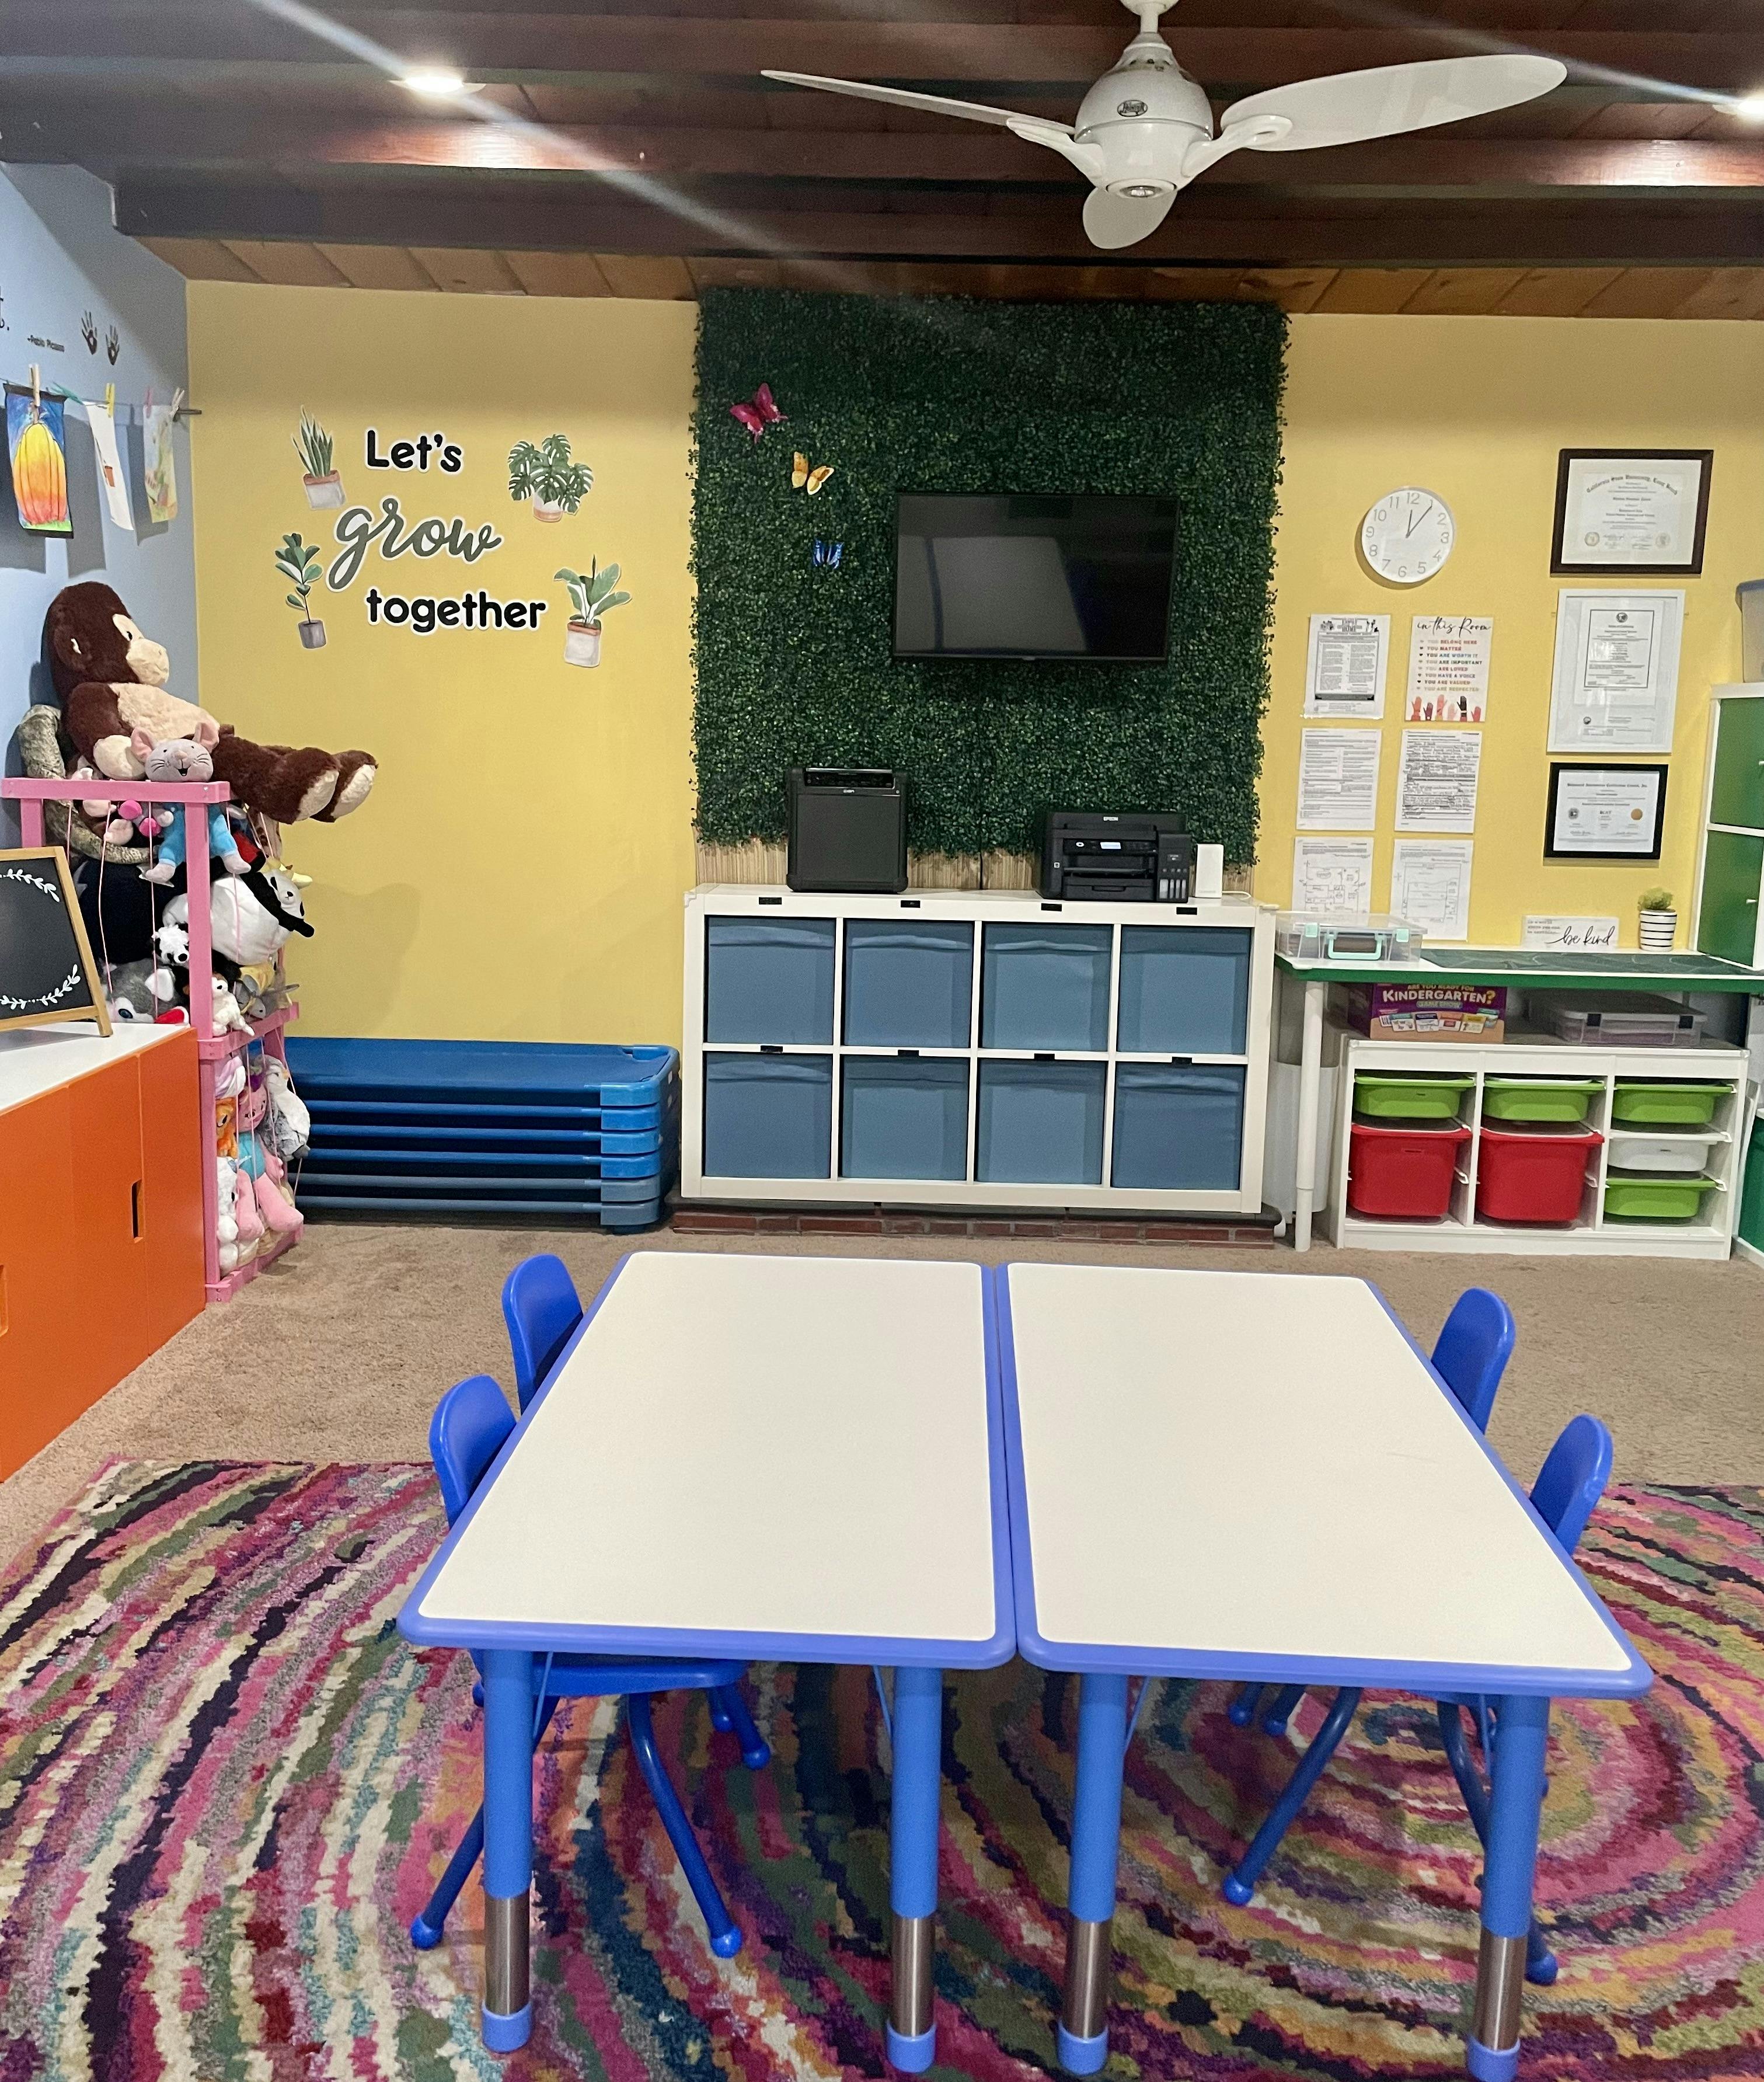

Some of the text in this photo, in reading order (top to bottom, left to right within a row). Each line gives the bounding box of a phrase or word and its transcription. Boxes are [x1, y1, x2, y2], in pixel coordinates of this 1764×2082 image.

[367, 430, 462, 472] Let's
[1389, 496, 1400, 509] 11
[1406, 492, 1420, 504] 12
[1373, 509, 1387, 521] 10
[1437, 513, 1447, 525] 2
[1365, 526, 1375, 538] 9
[1440, 532, 1450, 544] 3
[328, 497, 502, 590] grow
[1369, 544, 1378, 556] 8
[1432, 549, 1442, 562] 4
[1382, 559, 1392, 571] 7
[1417, 562, 1427, 574] 5
[1398, 566, 1407, 577] 6
[367, 589, 546, 633] together
[1544, 925, 1616, 946] be kind
[1383, 988, 1496, 1005] KINDERGARTEN?
